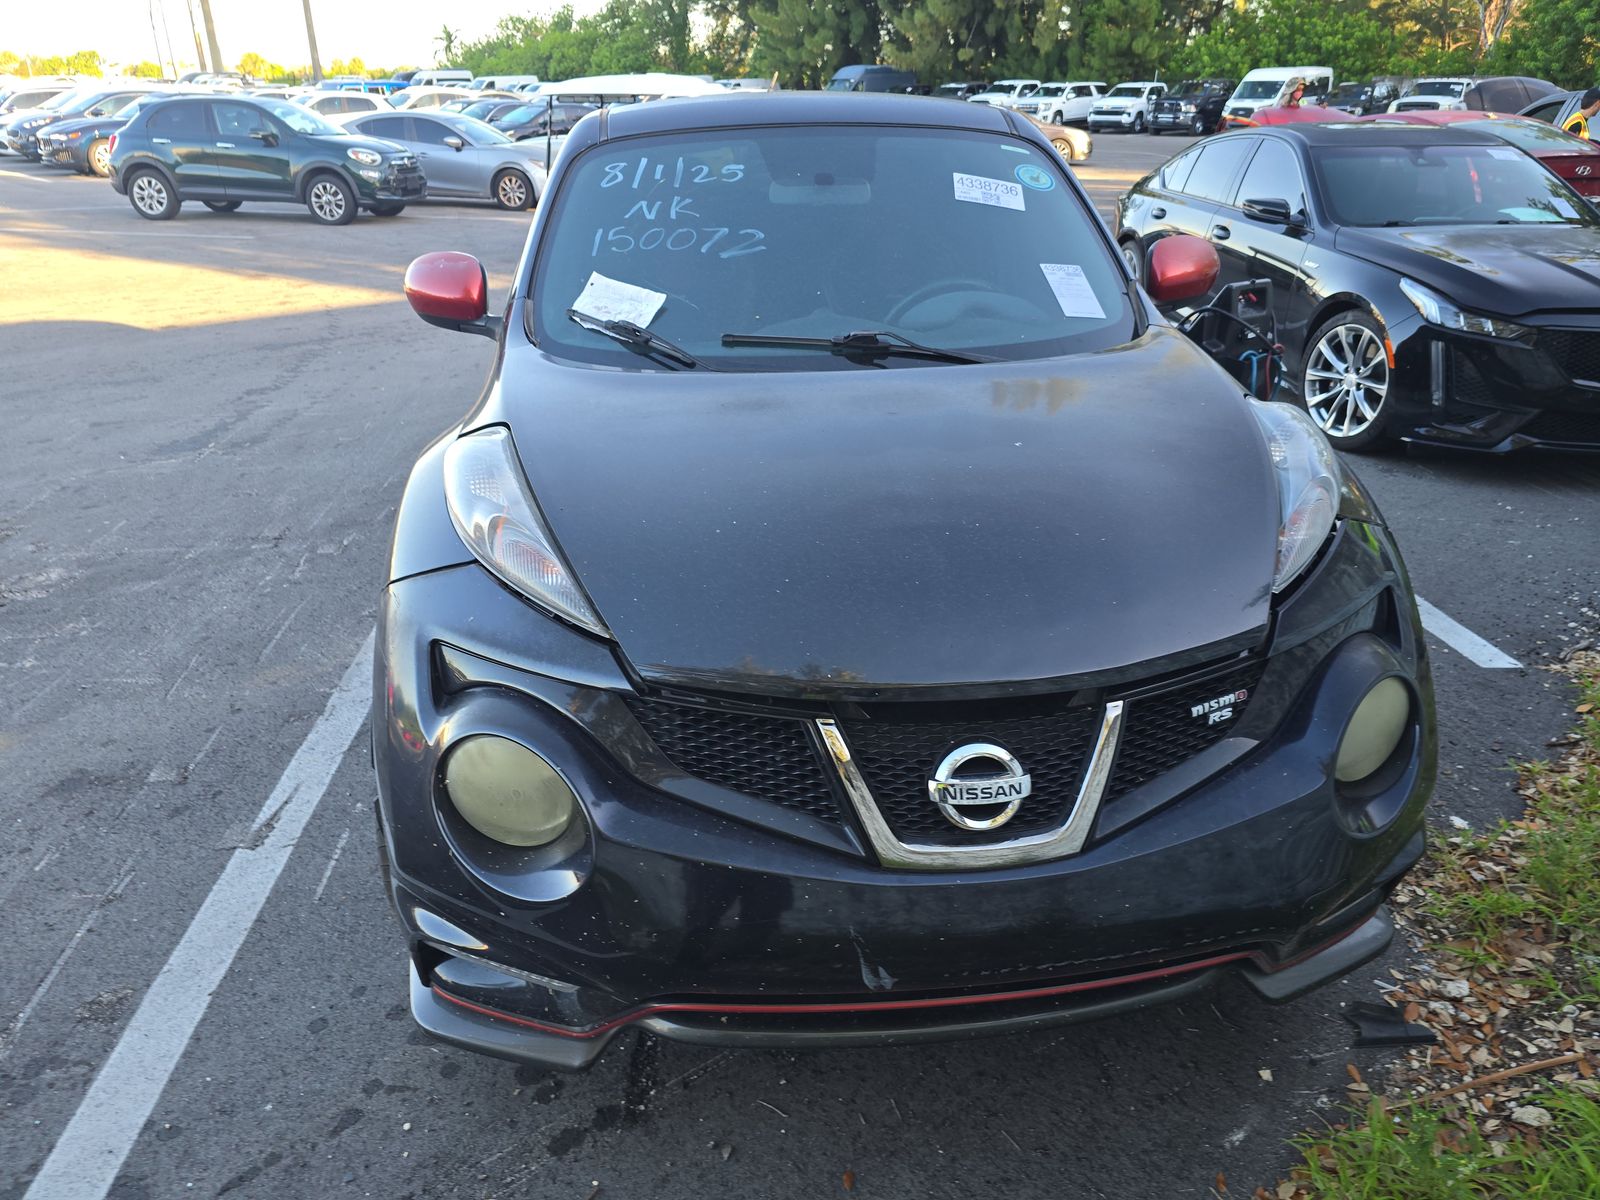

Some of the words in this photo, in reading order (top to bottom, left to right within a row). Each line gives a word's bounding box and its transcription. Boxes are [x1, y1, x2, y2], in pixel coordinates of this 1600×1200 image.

[600, 157, 745, 189] 8/1/25
[956, 176, 1019, 197] 4338736
[591, 226, 767, 259] 150072
[1208, 707, 1233, 725] RS
[941, 782, 1022, 801] NISSAN
